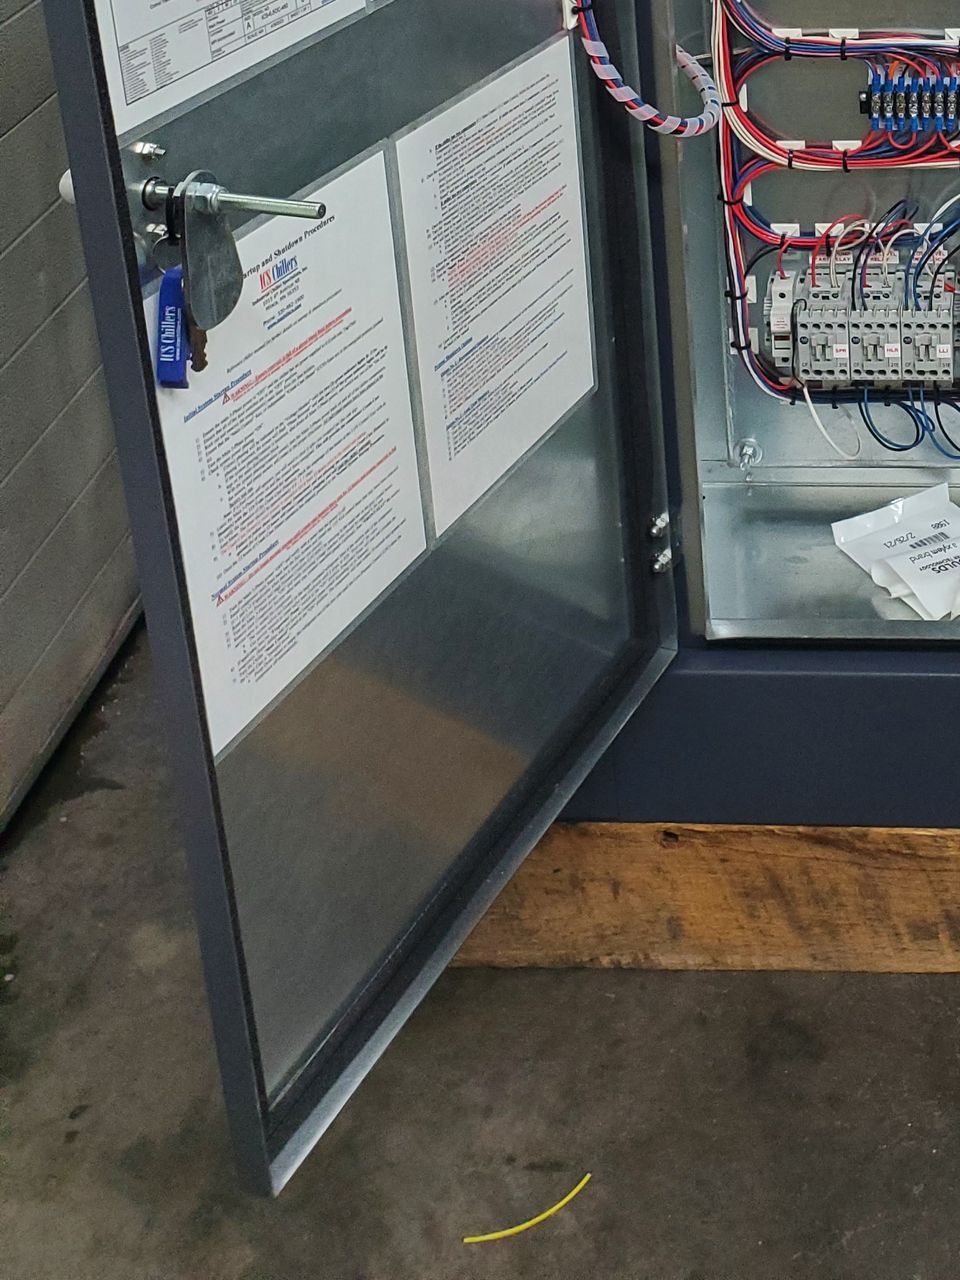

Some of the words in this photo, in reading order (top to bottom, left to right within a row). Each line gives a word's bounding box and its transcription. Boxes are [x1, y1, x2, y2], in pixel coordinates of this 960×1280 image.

[261, 254, 273, 268] and
[274, 236, 303, 259] Shutdown
[303, 214, 335, 239] Procedures
[260, 269, 272, 290] ICS
[271, 256, 298, 281] Chillers
[161, 306, 175, 343] Chillers
[160, 346, 174, 361] ICS
[909, 551, 931, 564] brand
